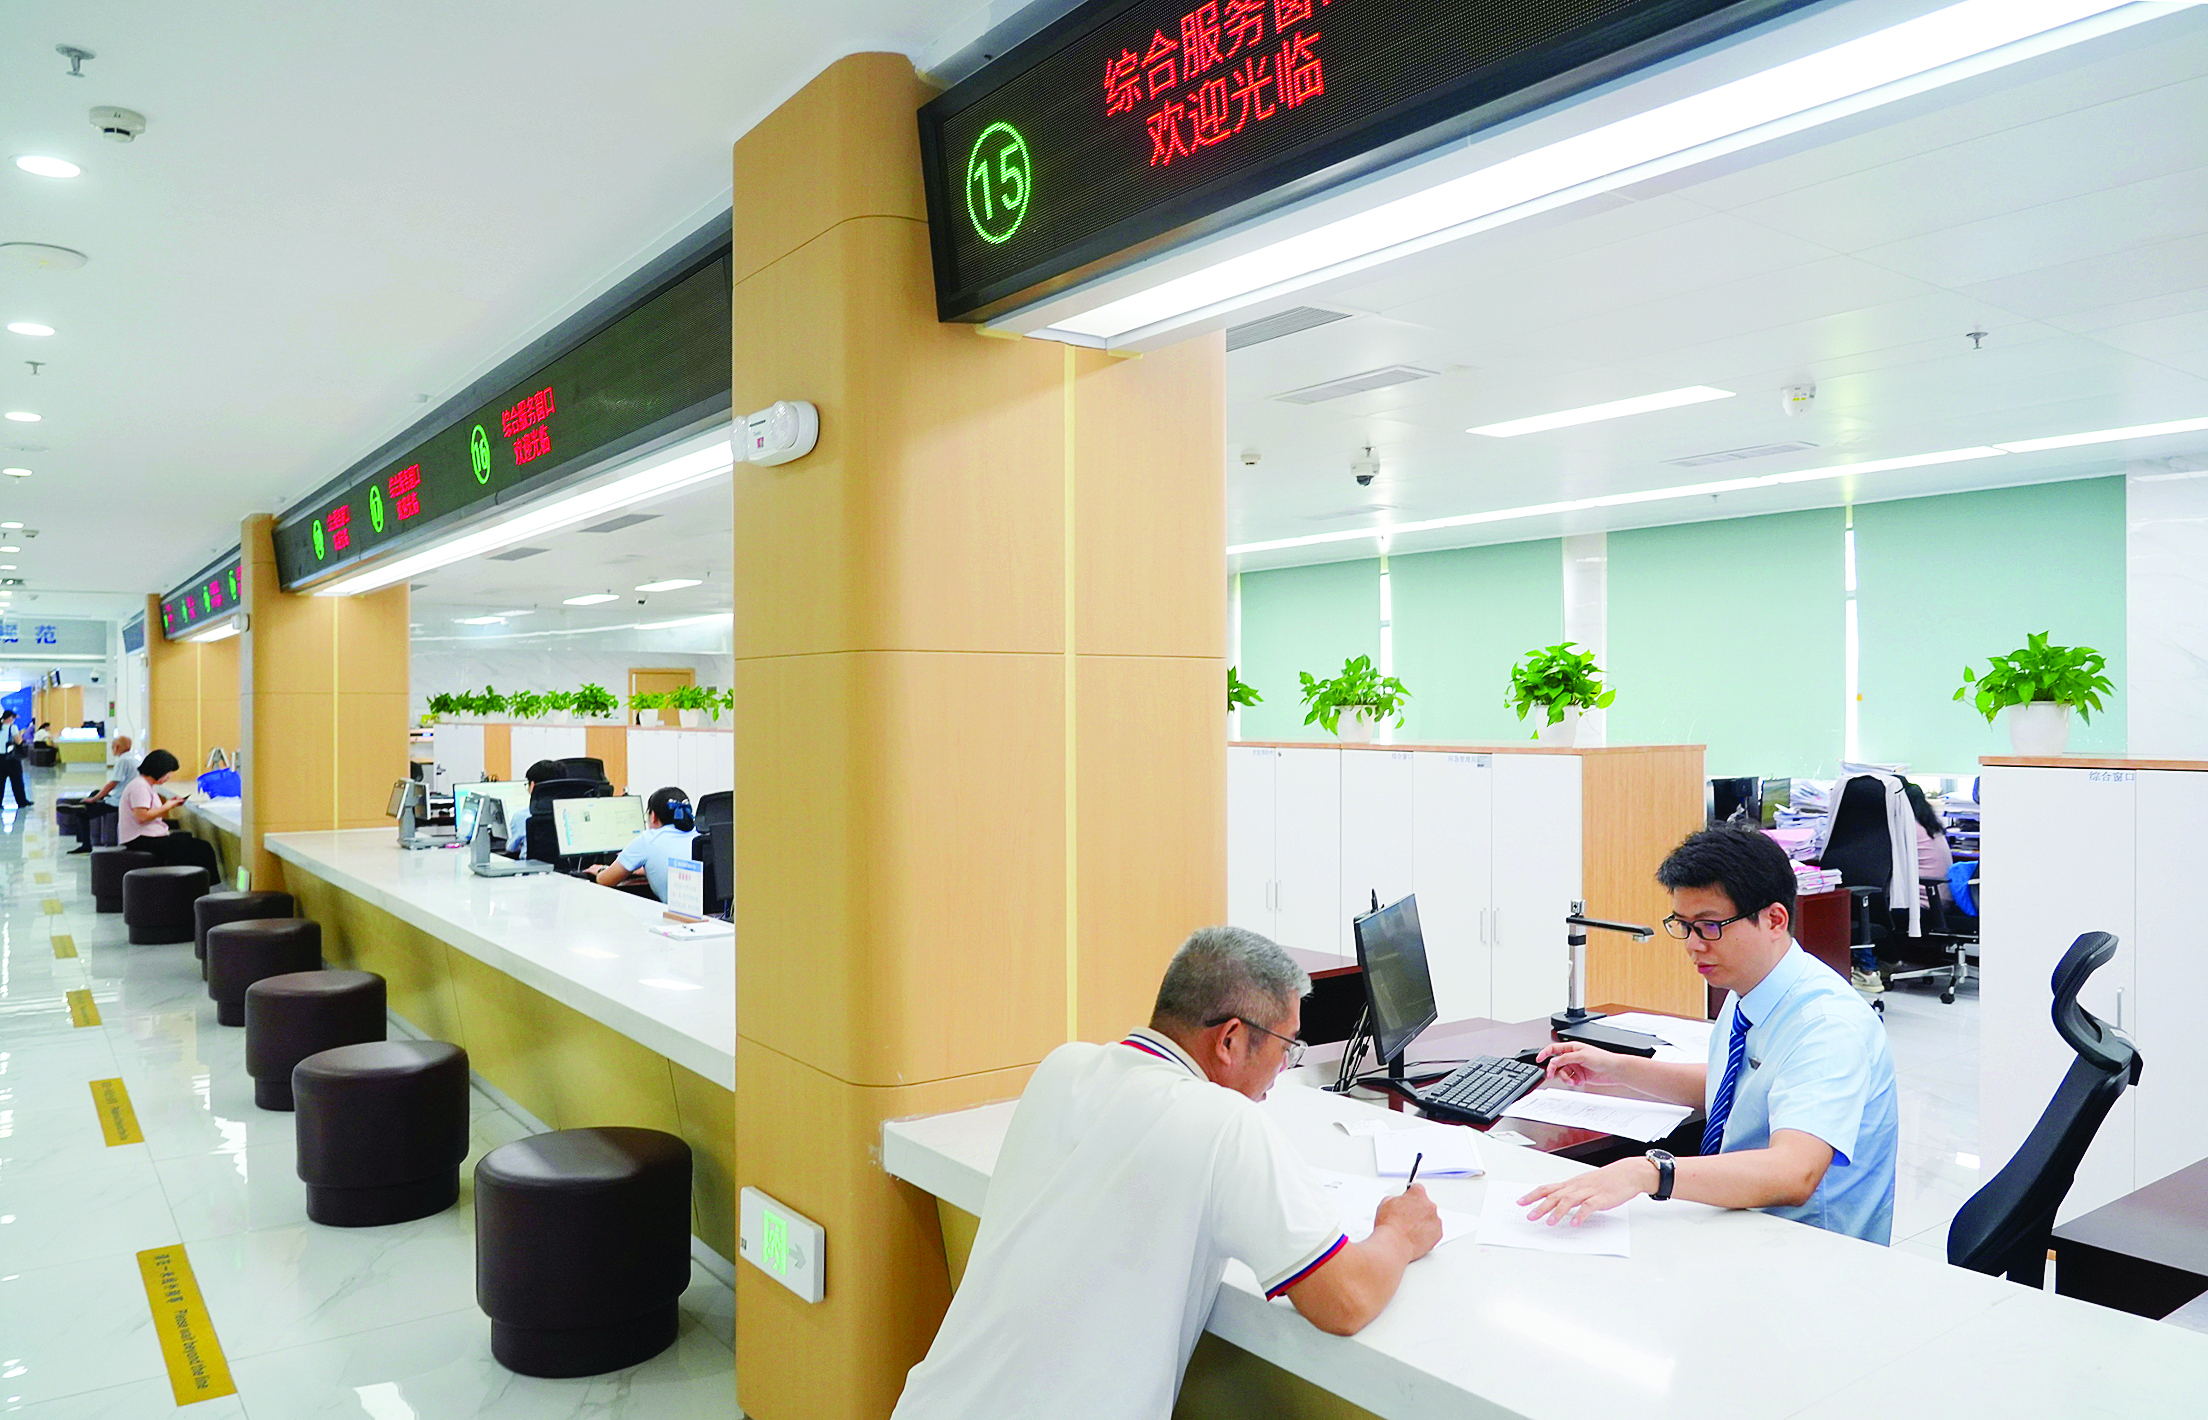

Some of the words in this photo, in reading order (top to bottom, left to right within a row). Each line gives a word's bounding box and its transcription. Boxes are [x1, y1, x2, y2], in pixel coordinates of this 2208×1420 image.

[1146, 31, 1325, 167] 欢迎光临
[974, 142, 1024, 221] 15
[474, 438, 488, 472] 16
[2089, 770, 2135, 782] 综合窗口
[174, 1307, 188, 1329] Please
[179, 1327, 196, 1341] wait
[182, 1340, 204, 1365] beyond
[190, 1364, 206, 1377] the
[194, 1374, 210, 1390] line
